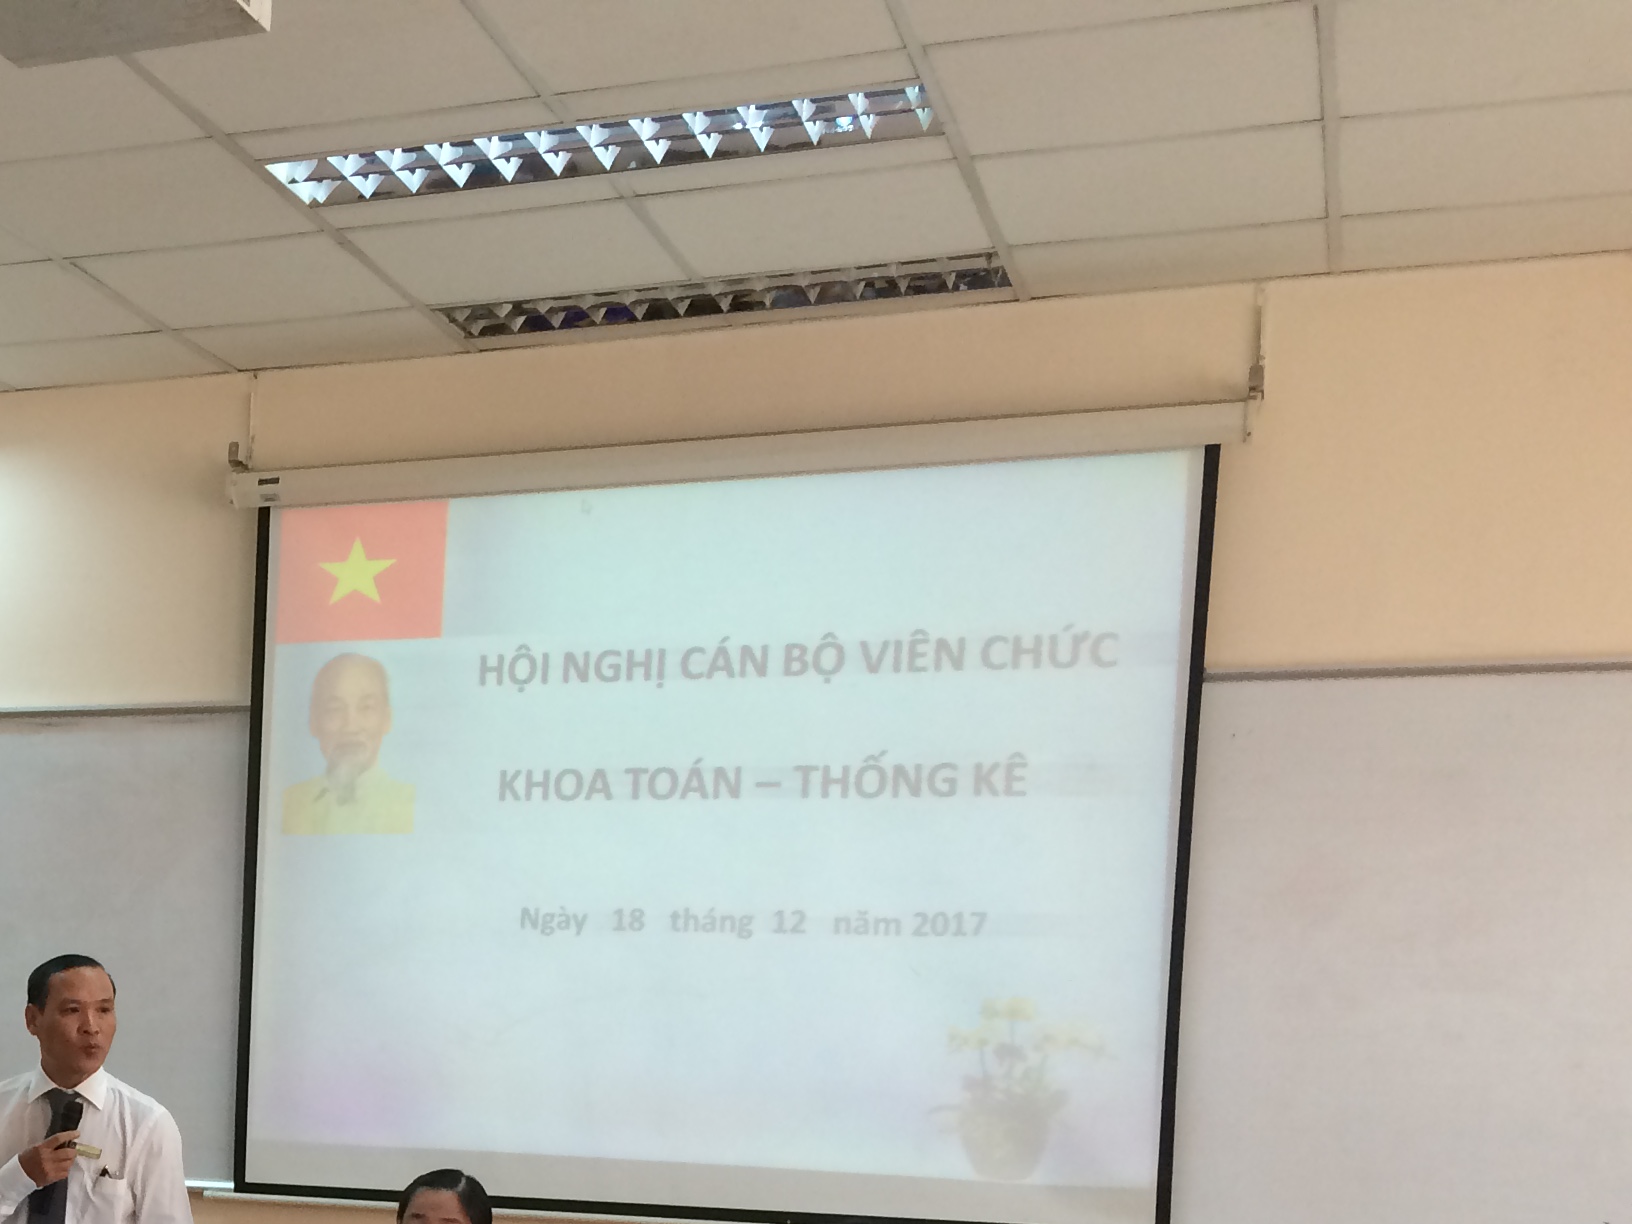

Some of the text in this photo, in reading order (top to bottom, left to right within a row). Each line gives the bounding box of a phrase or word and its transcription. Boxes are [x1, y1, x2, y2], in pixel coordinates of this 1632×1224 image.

[479, 623, 1119, 693] HỘI NGHỊ CÁN BỘ VIÊN CHỨC
[498, 767, 613, 801] KHOA
[624, 757, 742, 800] TOÁN
[793, 750, 958, 799] THỐNG
[973, 752, 1028, 797] KÊ
[520, 906, 988, 940] Ngày 18 tháng 12 năm 2017
